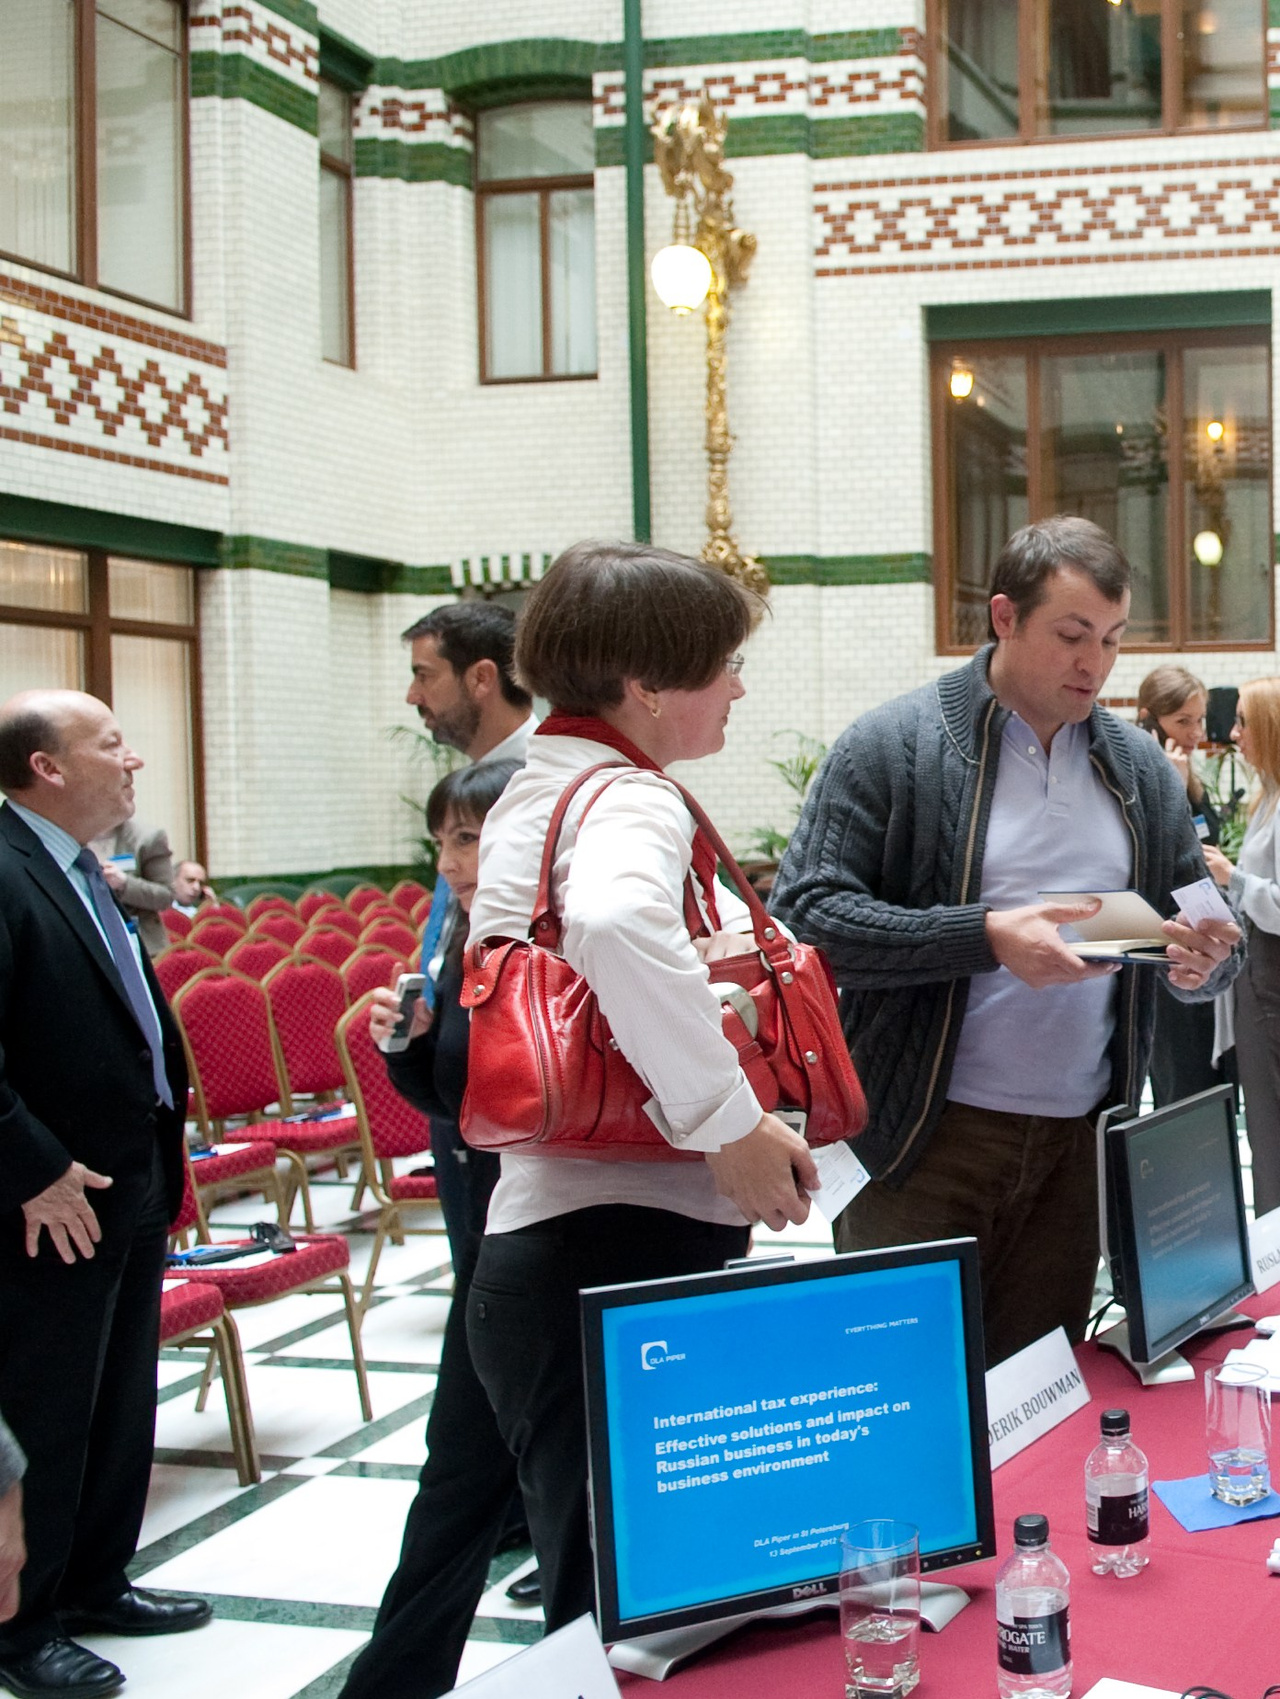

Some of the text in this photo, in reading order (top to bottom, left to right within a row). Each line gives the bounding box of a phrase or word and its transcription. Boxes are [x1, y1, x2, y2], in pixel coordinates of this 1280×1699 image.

[888, 1317, 919, 1327] MATTERS
[653, 1381, 879, 1430] International tax experience:
[1021, 1368, 1081, 1421] BOUWMAN
[655, 1400, 911, 1455] Effective solutions and impact on
[656, 1424, 871, 1475] Russian business in today's
[656, 1450, 830, 1494] business environment
[792, 1582, 827, 1600] DELL
